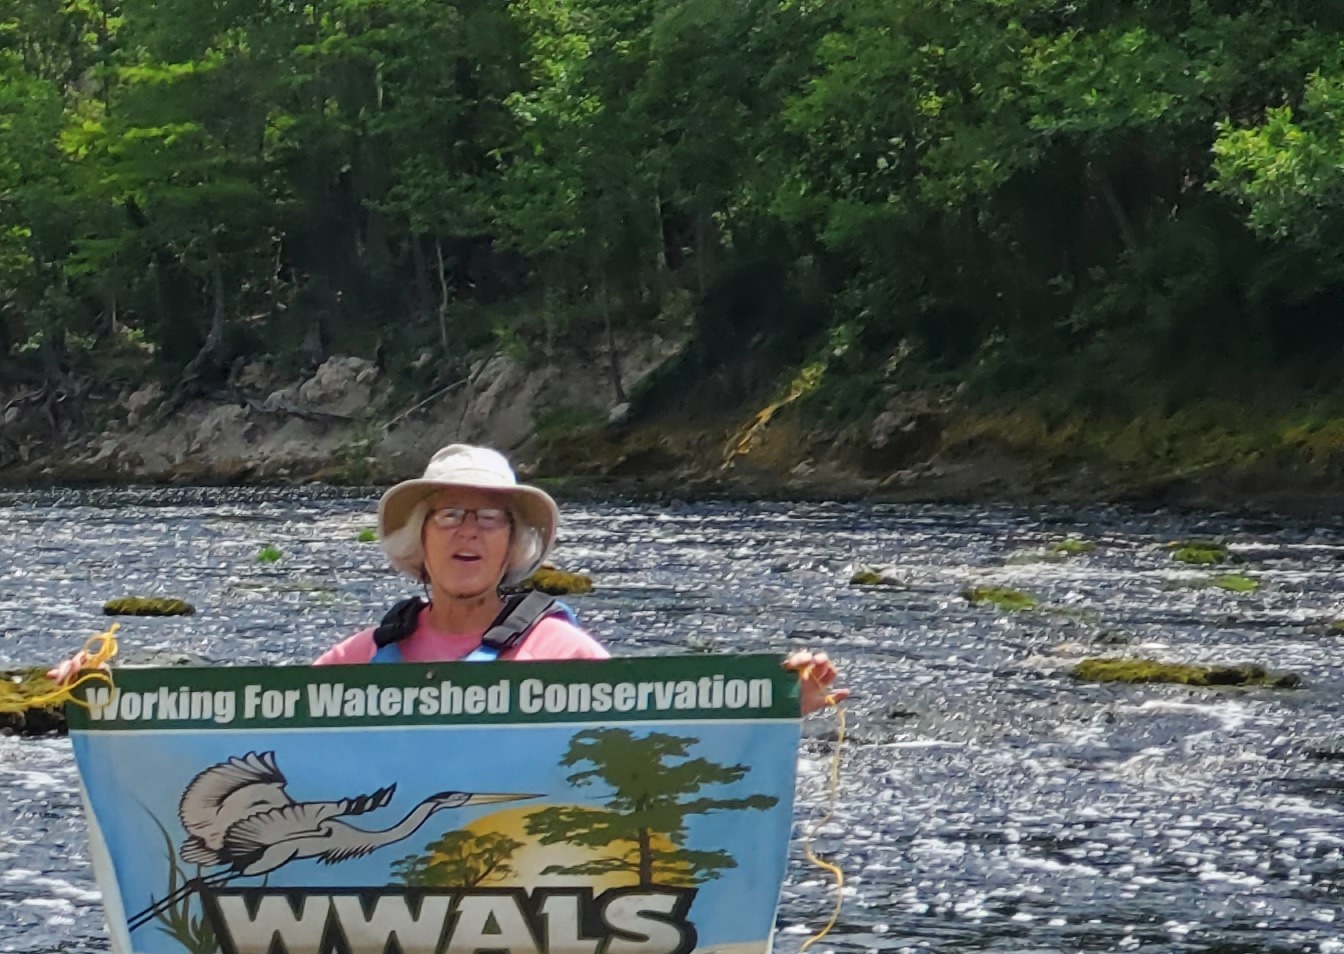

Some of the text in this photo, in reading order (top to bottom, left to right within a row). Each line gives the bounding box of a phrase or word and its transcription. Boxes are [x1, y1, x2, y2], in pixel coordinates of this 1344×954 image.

[85, 673, 774, 724] Working For Watershed Conservation
